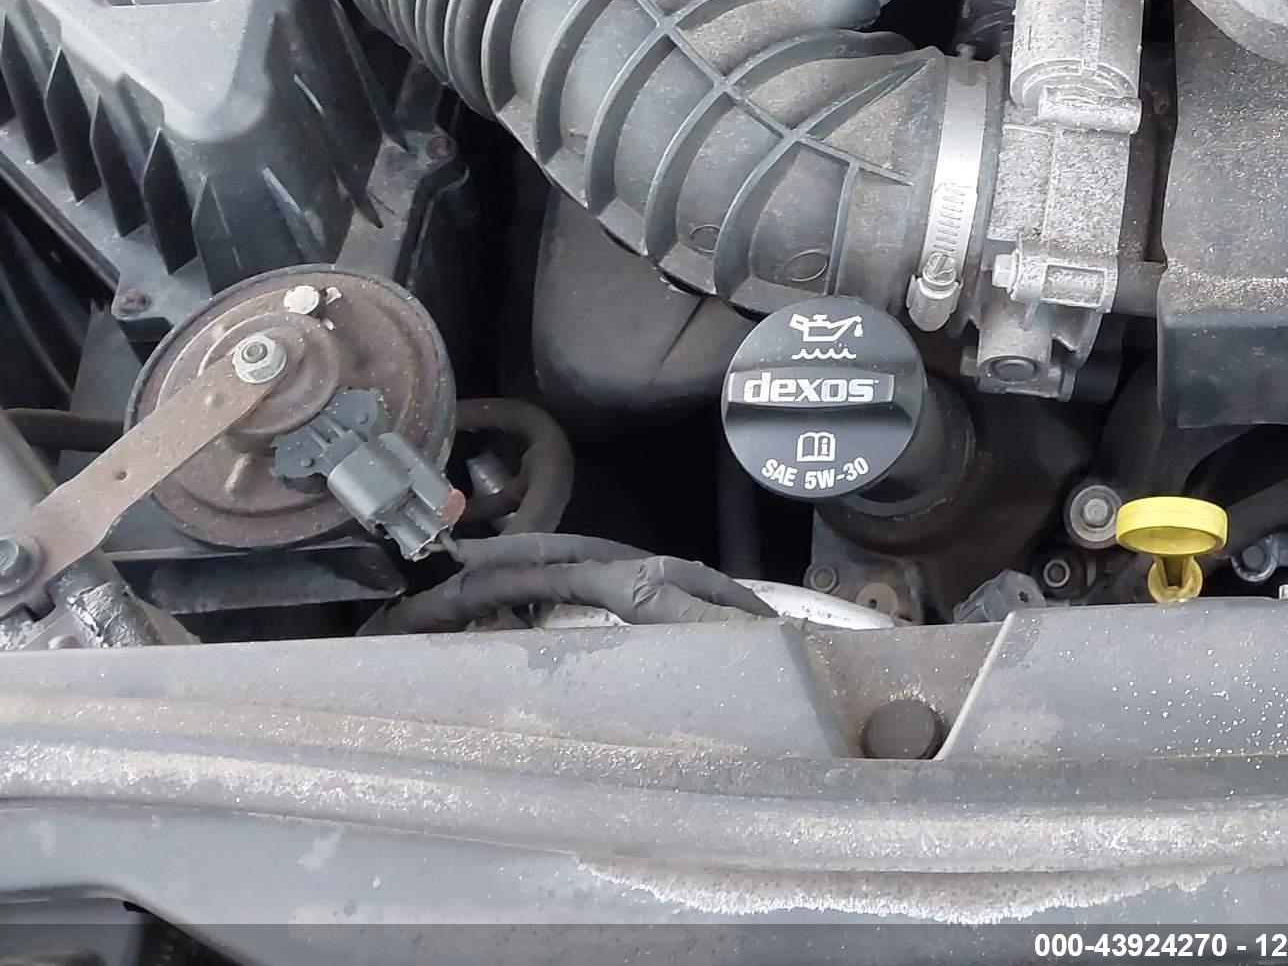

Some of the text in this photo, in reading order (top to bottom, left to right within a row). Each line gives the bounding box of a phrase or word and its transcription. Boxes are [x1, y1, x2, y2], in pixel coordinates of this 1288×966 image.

[743, 372, 875, 403] dexos
[761, 456, 869, 490] SAE 5W-30
